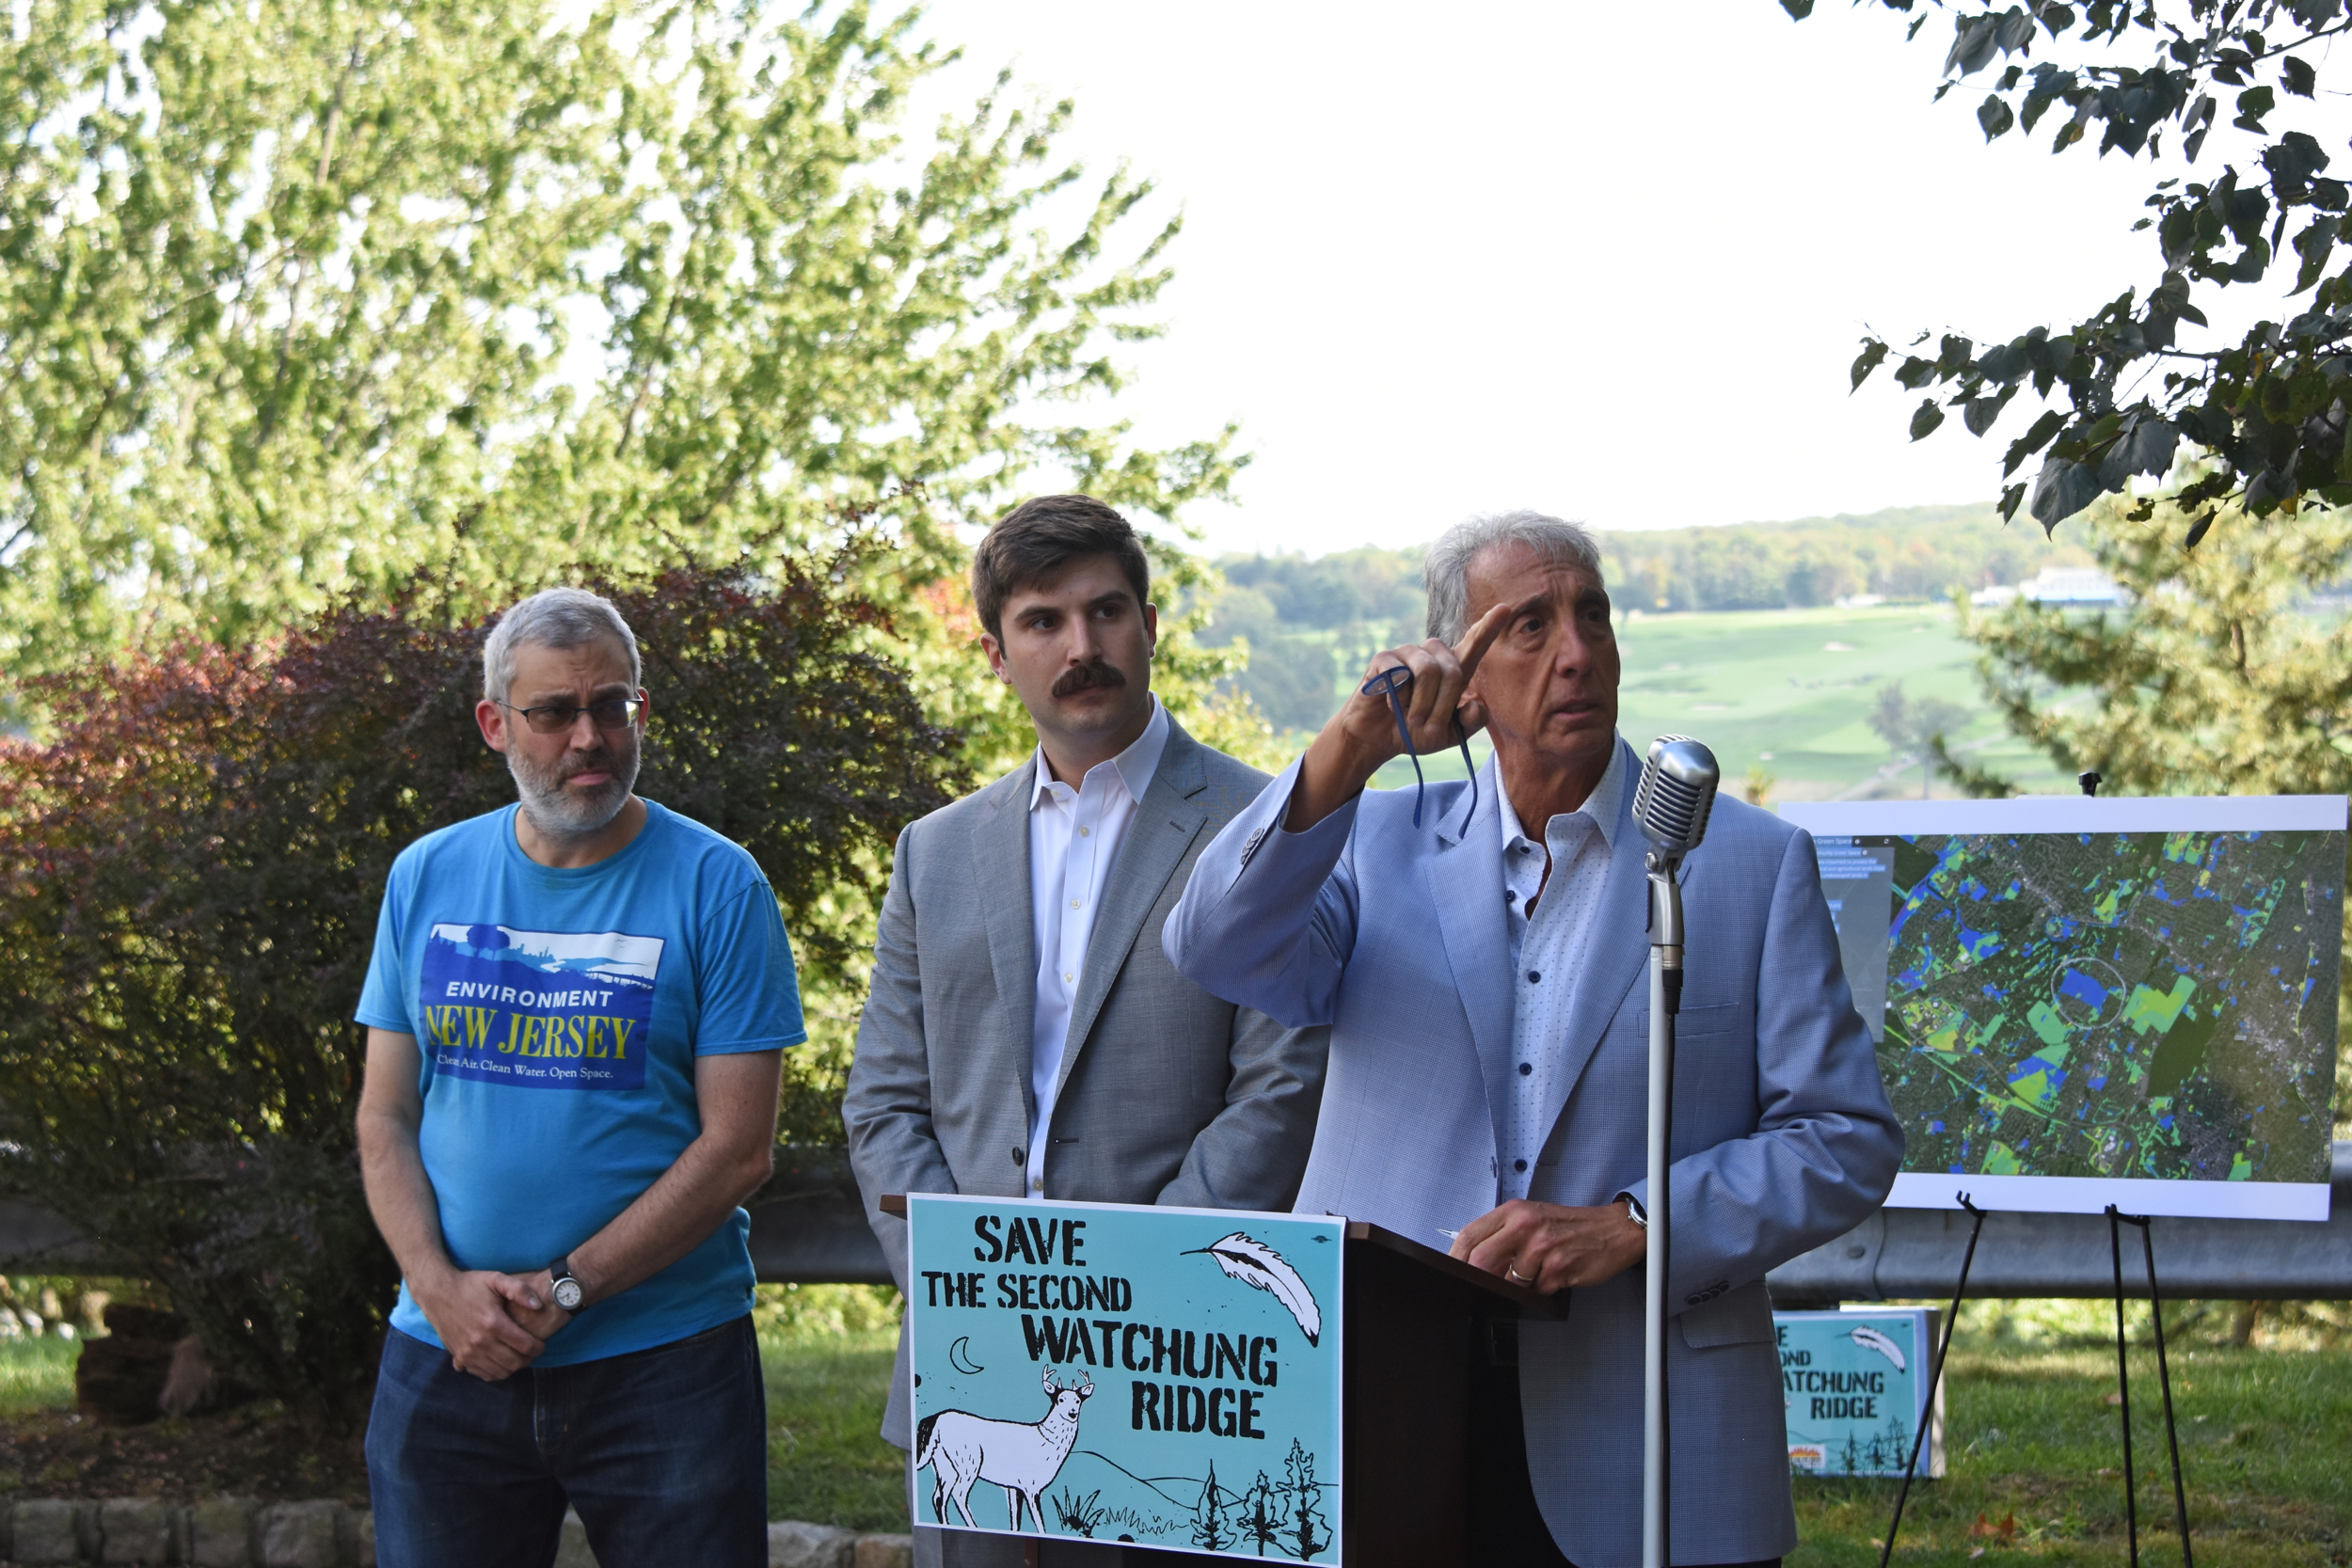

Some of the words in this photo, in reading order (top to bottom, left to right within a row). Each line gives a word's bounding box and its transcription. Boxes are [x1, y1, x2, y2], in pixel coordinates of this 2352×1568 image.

[446, 981, 613, 1008] ENVIRONMENT
[425, 1005, 498, 1050] NEW
[498, 1012, 636, 1059] JERSEY
[461, 1057, 479, 1069] Air.
[481, 1059, 511, 1074] Clean
[515, 1064, 547, 1077] Water.
[549, 1067, 578, 1079] Open
[580, 1068, 613, 1080] Space.
[974, 1215, 1087, 1267] SAVE
[921, 1271, 986, 1308] THE
[997, 1274, 1133, 1312] SECOND
[1021, 1314, 1278, 1387] WATCHUNG
[1132, 1380, 1266, 1440] RIDGE
[1810, 1396, 1878, 1420] RIDGE
